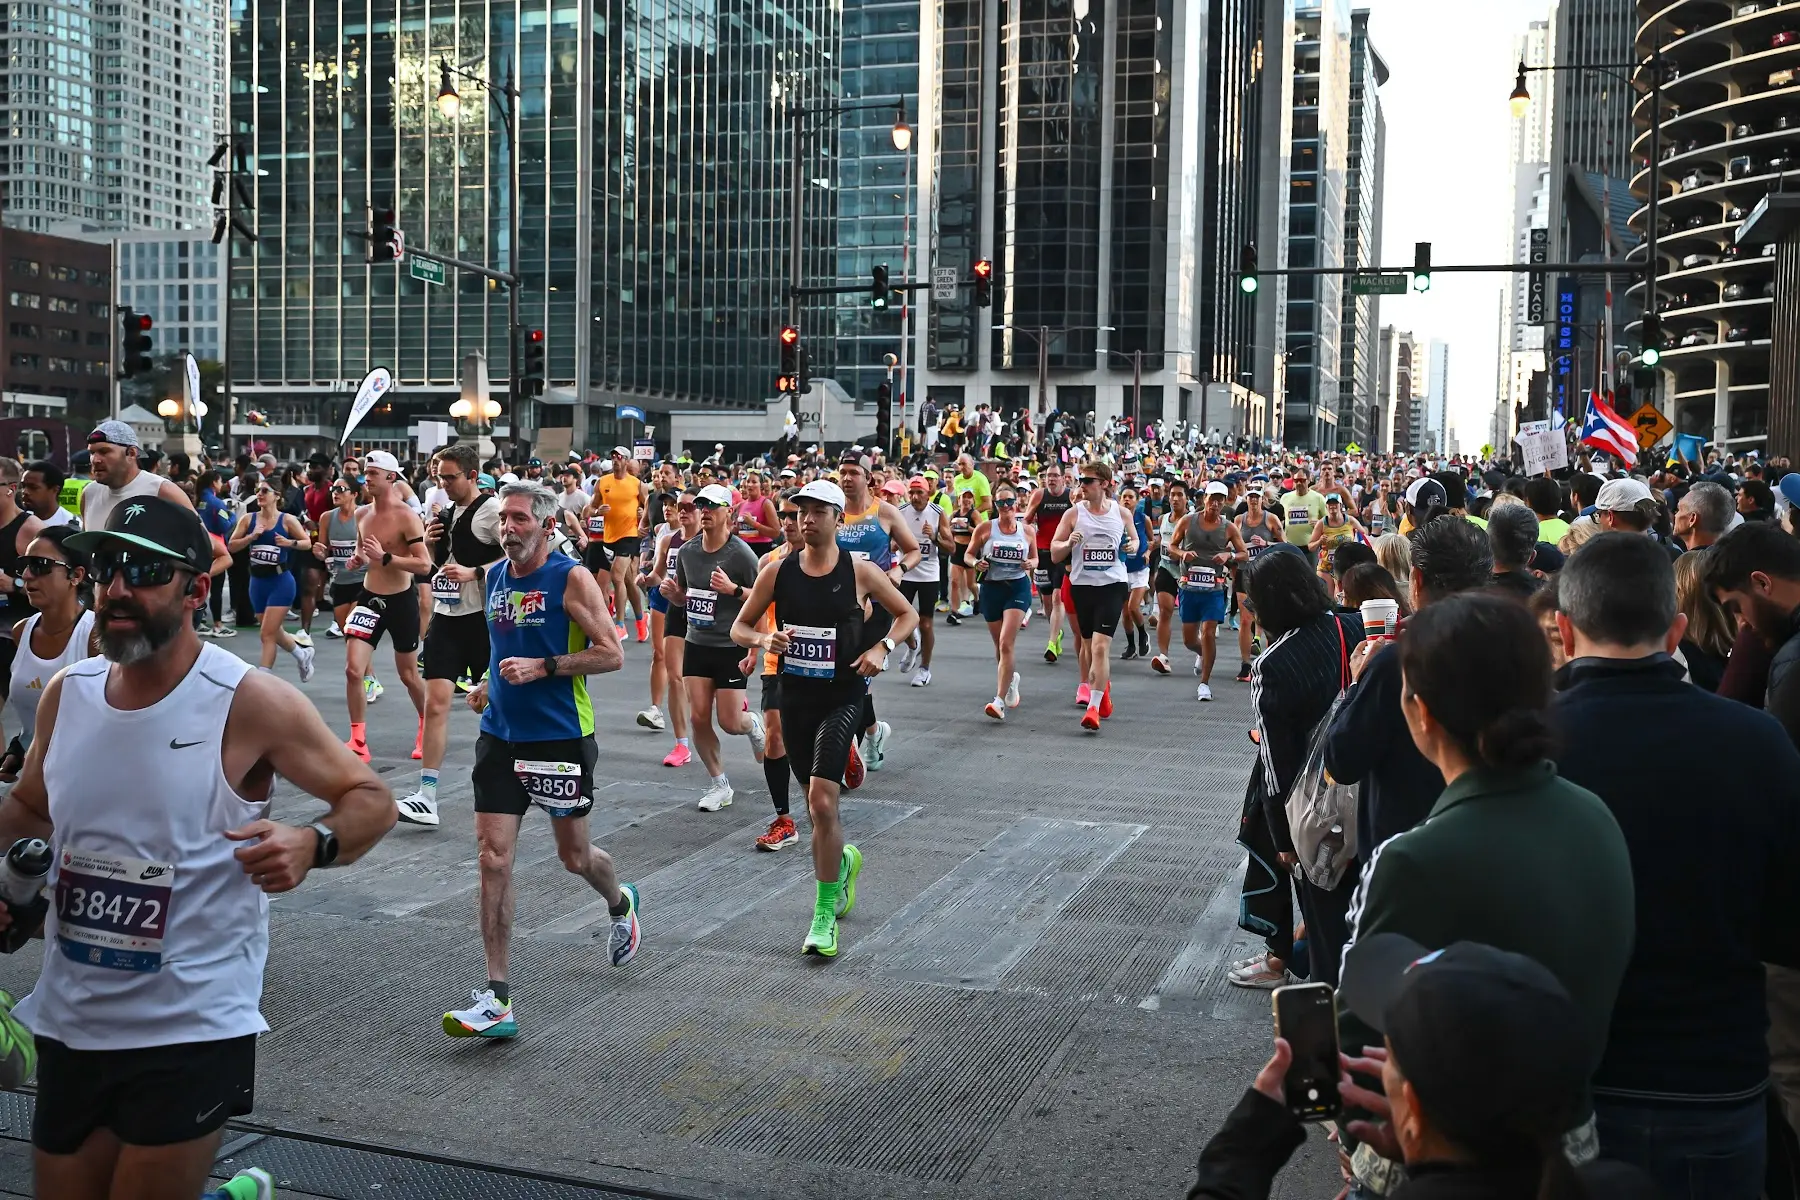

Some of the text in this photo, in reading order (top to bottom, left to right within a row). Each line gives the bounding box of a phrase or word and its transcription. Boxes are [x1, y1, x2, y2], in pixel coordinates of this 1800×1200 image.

[1360, 277, 1395, 286] WACKER
[1531, 252, 1544, 322] CICAGO
[837, 530, 866, 538] SHOP
[1090, 551, 1114, 560] 8806
[531, 776, 577, 797] 3850
[72, 860, 96, 870] CHICAGO
[145, 865, 165, 875] RUN
[69, 887, 161, 929] 38472
[73, 930, 99, 940] OCTOBER
